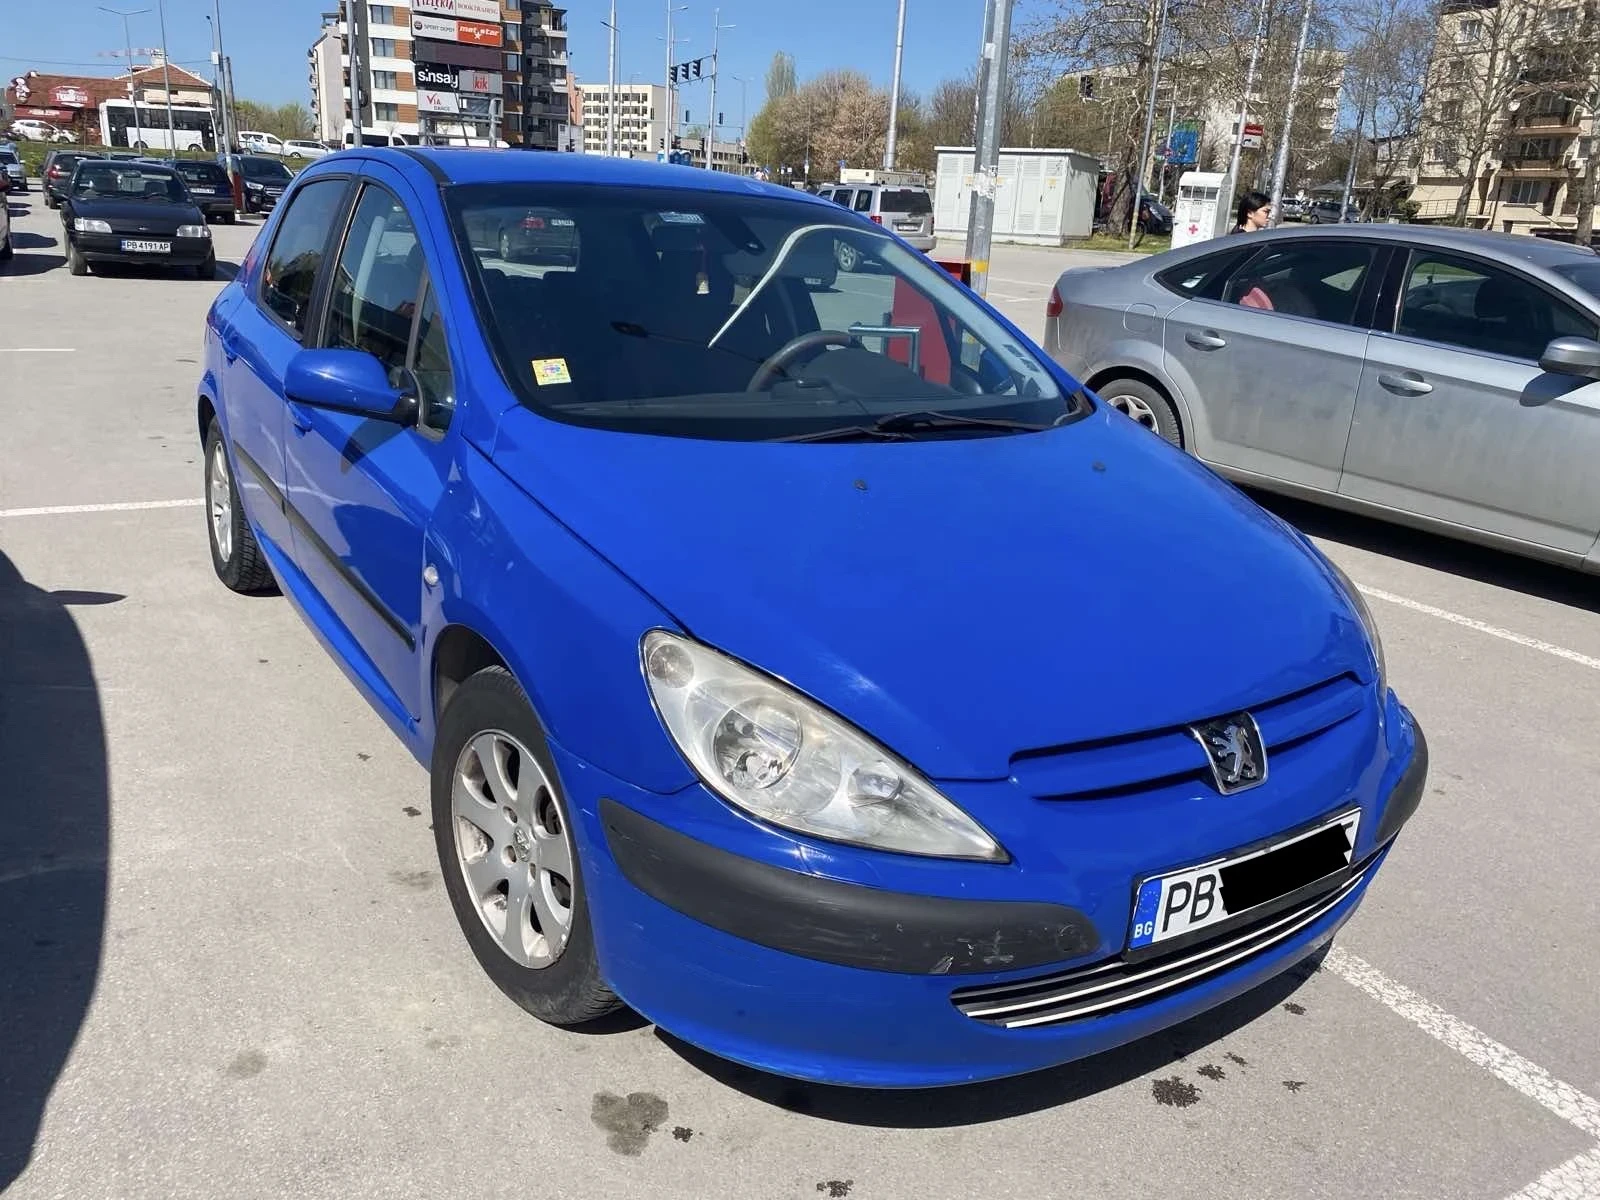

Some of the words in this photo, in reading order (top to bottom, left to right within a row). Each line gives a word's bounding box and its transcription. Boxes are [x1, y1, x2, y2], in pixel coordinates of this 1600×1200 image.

[418, 69, 458, 88] sinsay
[474, 76, 488, 89] kik
[127, 241, 138, 249] PB
[1162, 874, 1217, 933] PB
[1134, 921, 1153, 938] BG
